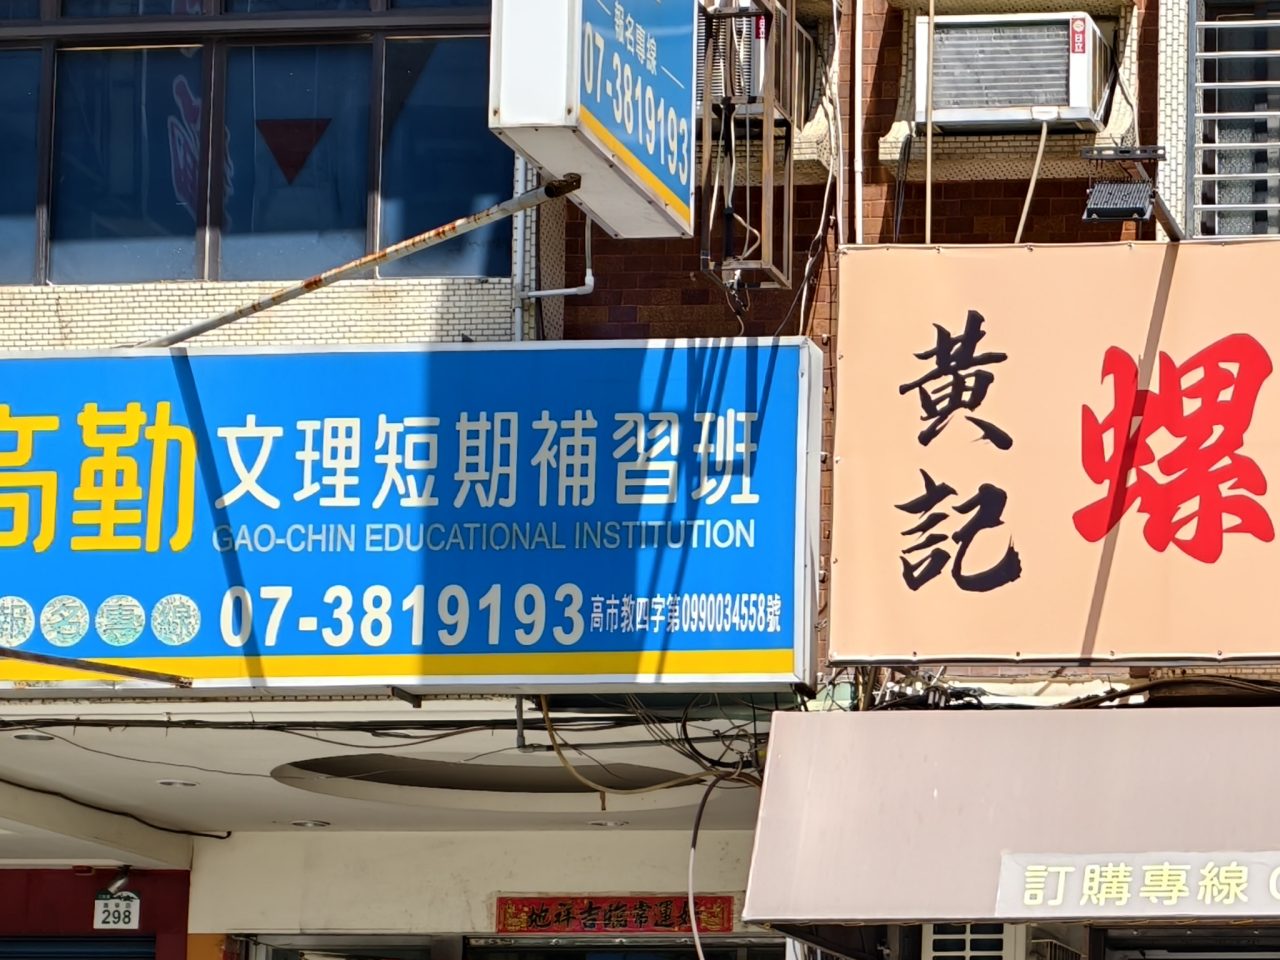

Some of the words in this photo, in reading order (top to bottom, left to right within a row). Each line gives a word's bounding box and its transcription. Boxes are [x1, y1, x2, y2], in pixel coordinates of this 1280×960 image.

[583, 22, 689, 186] 07-3819193
[214, 407, 761, 511] 文理短期補習班
[894, 308, 1023, 592] 黃記
[212, 522, 356, 554] GAO-CHIN
[364, 521, 567, 553] EDUCATIONAL
[574, 518, 756, 550] INSTITUTION
[220, 583, 585, 649] 07-3819193
[1023, 859, 1251, 907] 訂購專線
[101, 909, 131, 925] 298
